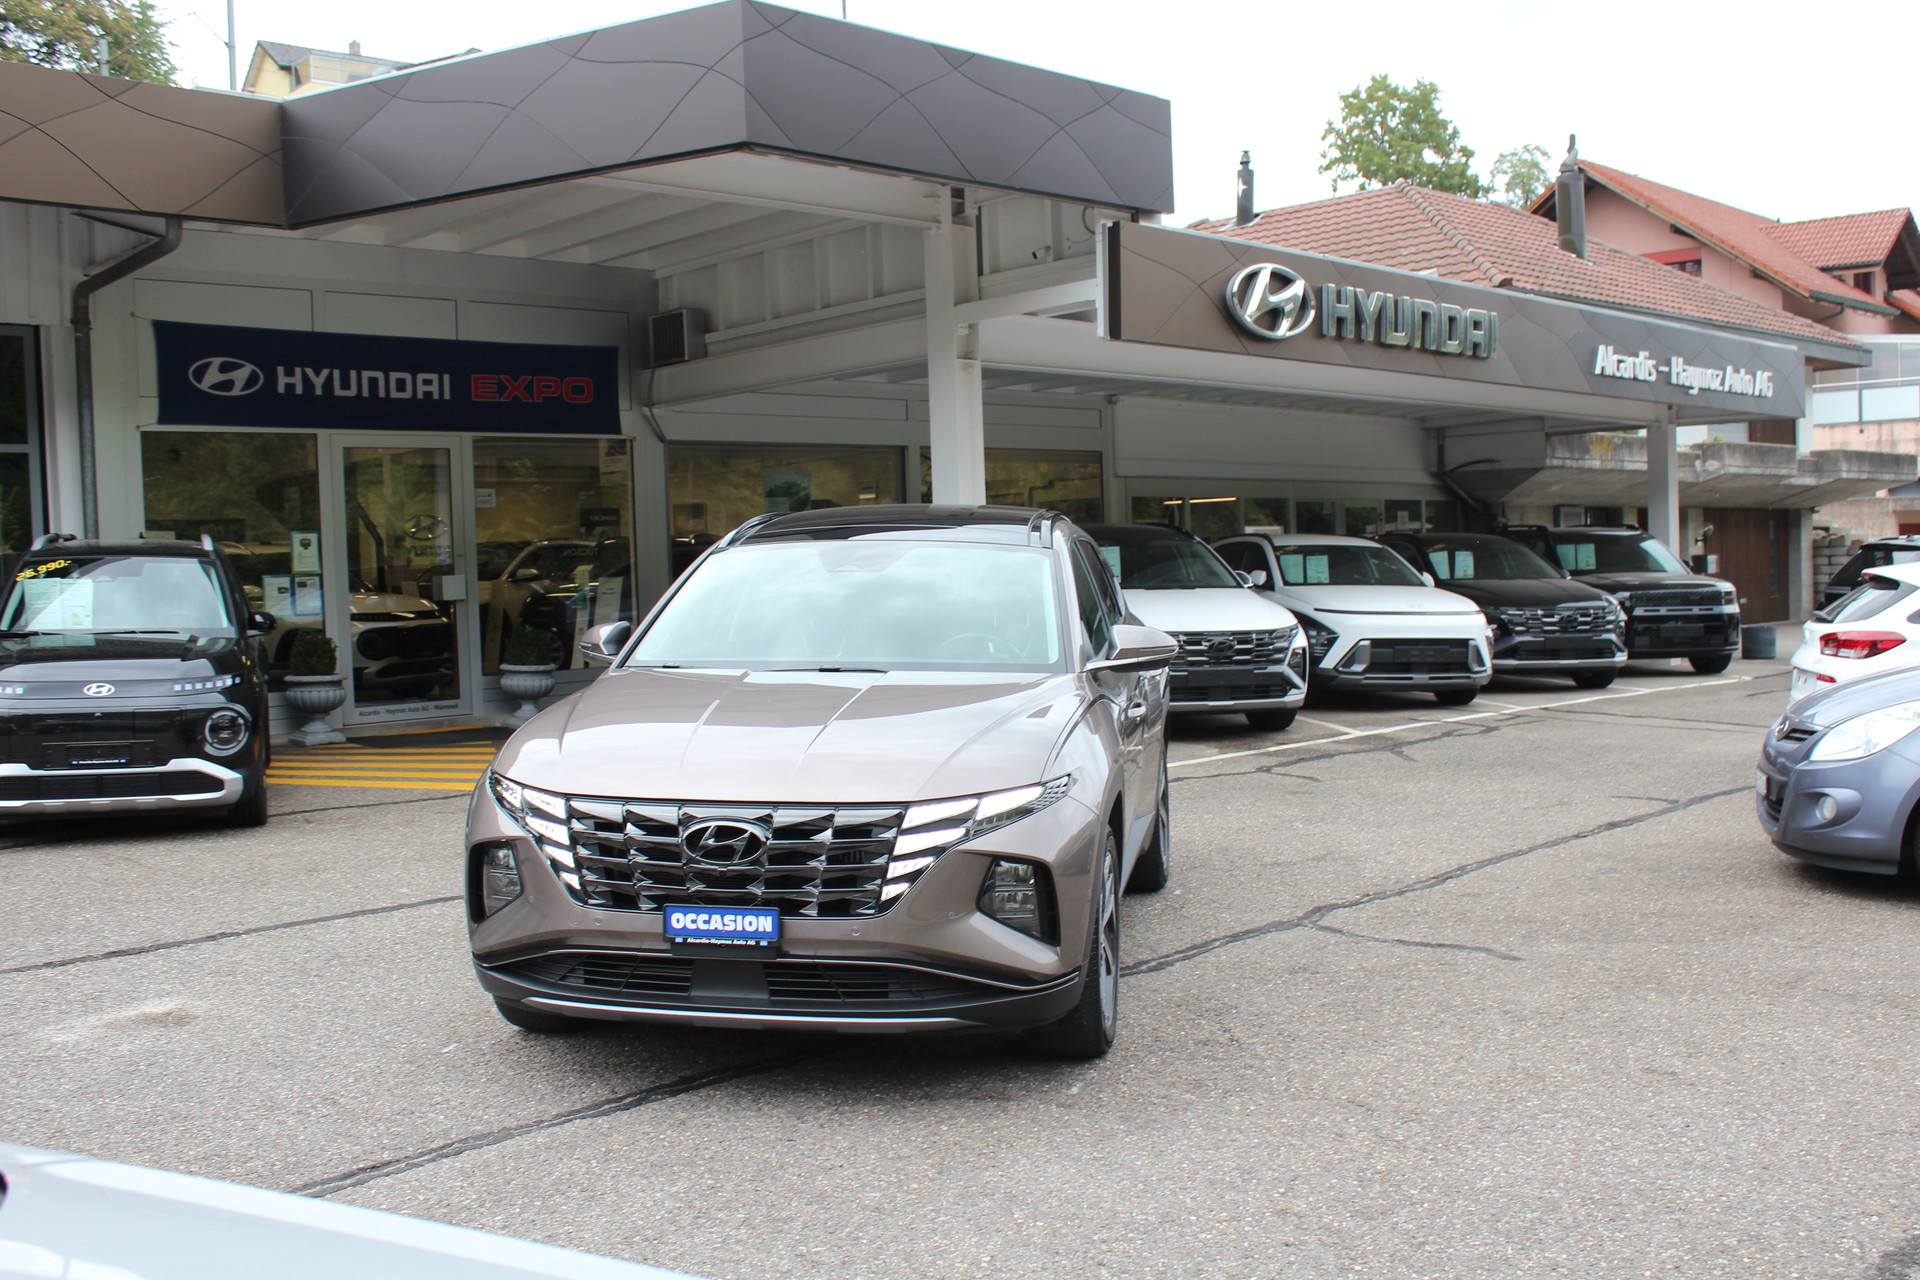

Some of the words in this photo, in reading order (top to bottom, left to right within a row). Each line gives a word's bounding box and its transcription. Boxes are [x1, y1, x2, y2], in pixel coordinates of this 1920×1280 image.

[1321, 283, 1498, 359] HYUNDAI
[276, 366, 450, 400] HYUNDAI
[470, 374, 594, 403] EXPO
[1594, 344, 1657, 382] Alcardis
[1670, 355, 1723, 396] Haymoz
[1723, 364, 1754, 395] Auto
[1753, 370, 1774, 398] AG
[670, 912, 773, 932] OCCASION
